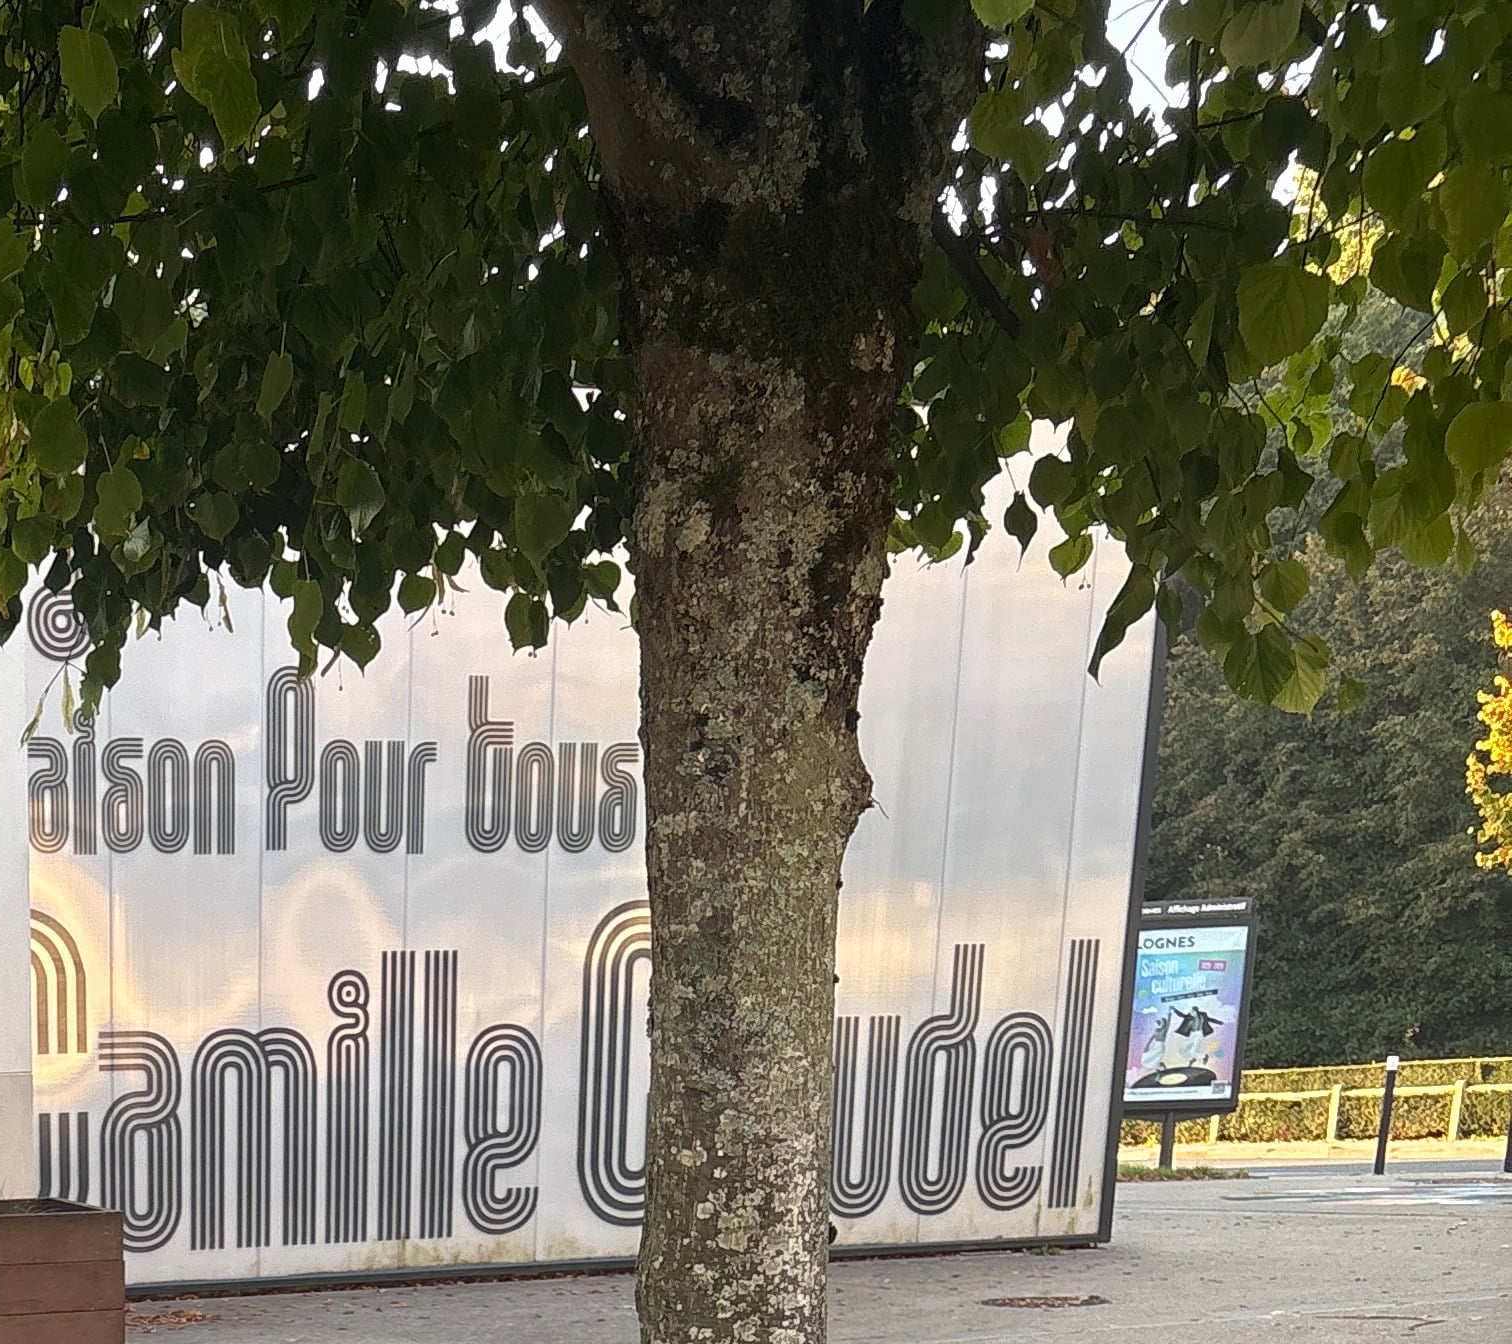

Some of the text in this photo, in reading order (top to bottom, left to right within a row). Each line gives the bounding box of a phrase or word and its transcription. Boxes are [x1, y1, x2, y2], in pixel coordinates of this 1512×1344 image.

[27, 666, 640, 855] aison Pour tous
[1141, 958, 1179, 977] Saison
